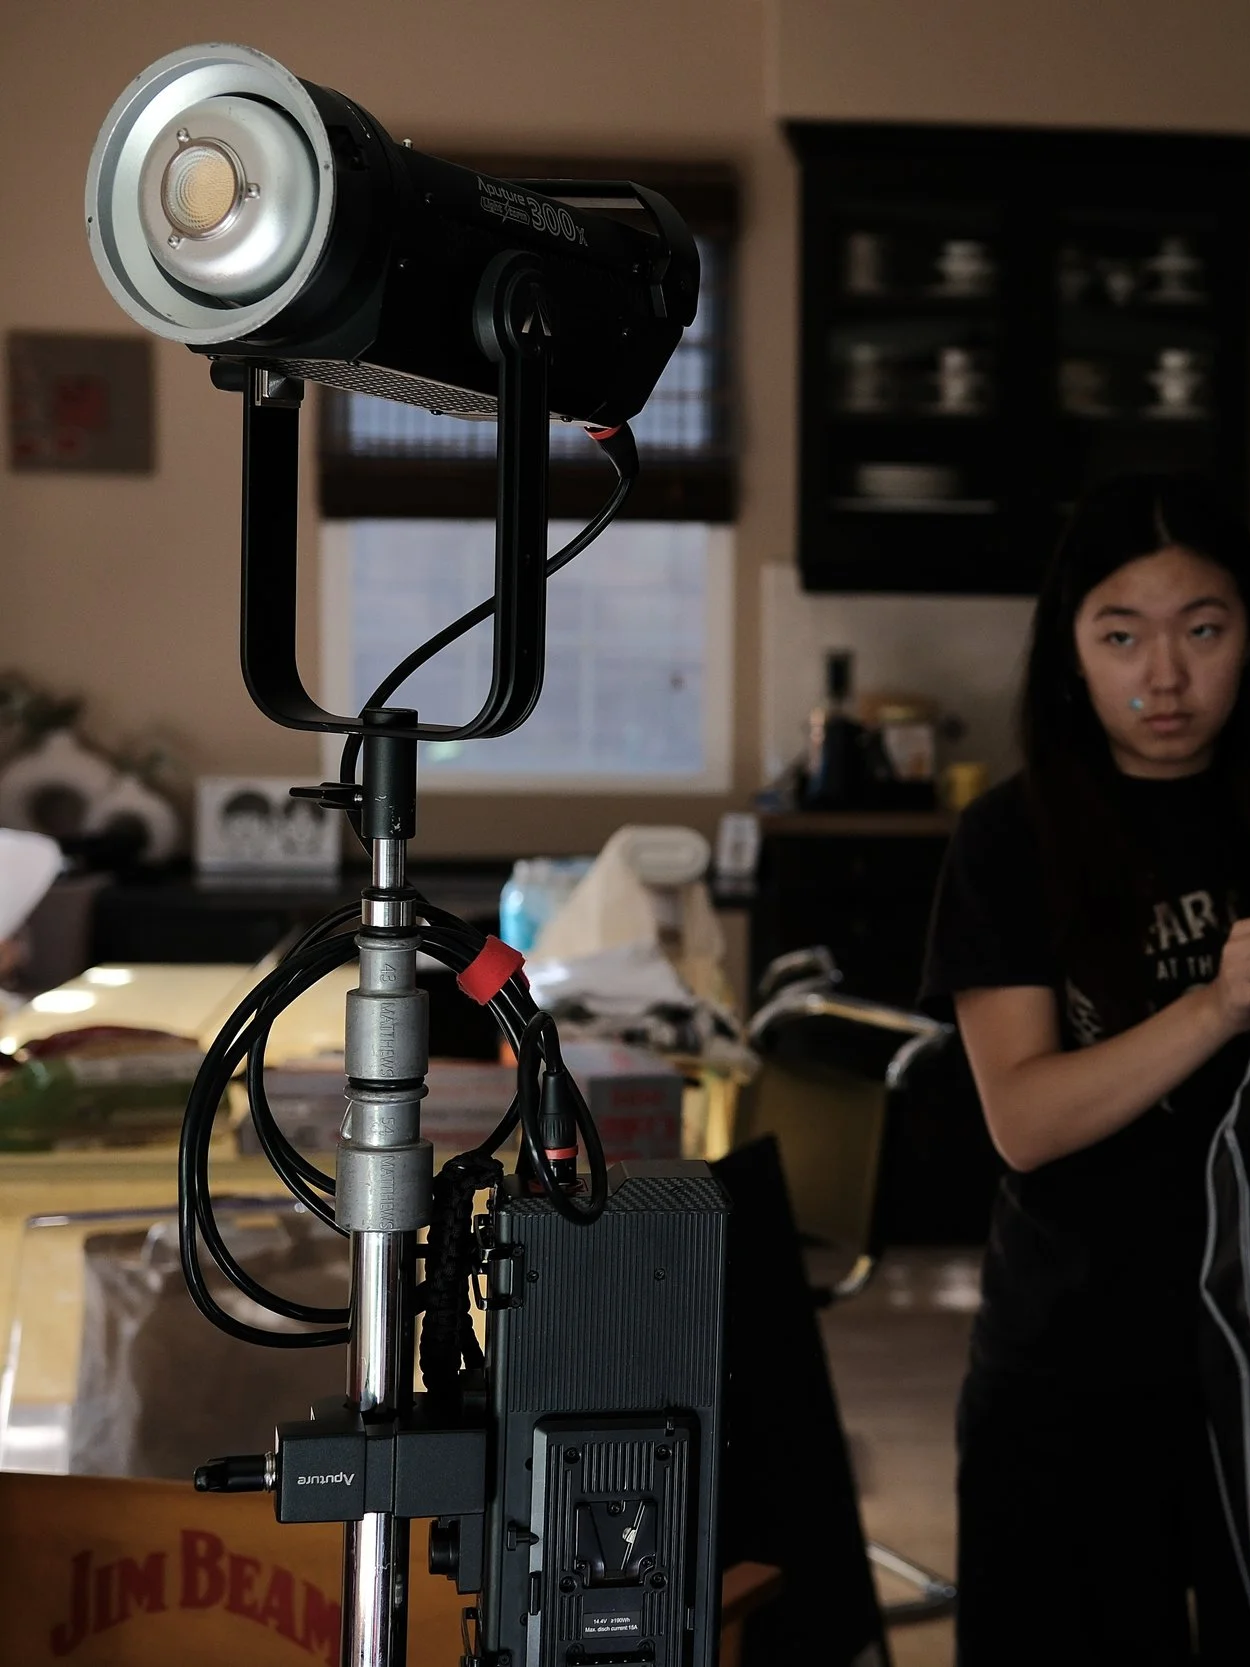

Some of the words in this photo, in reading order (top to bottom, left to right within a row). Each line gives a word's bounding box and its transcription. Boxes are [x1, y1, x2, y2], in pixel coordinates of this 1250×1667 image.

[476, 176, 526, 206] Aputure
[379, 963, 397, 984] 43
[379, 1002, 397, 1078] MATTHEWS
[379, 1155, 396, 1231] MATTHEWS
[297, 1471, 355, 1486] Aputure
[50, 1550, 169, 1658] JIM
